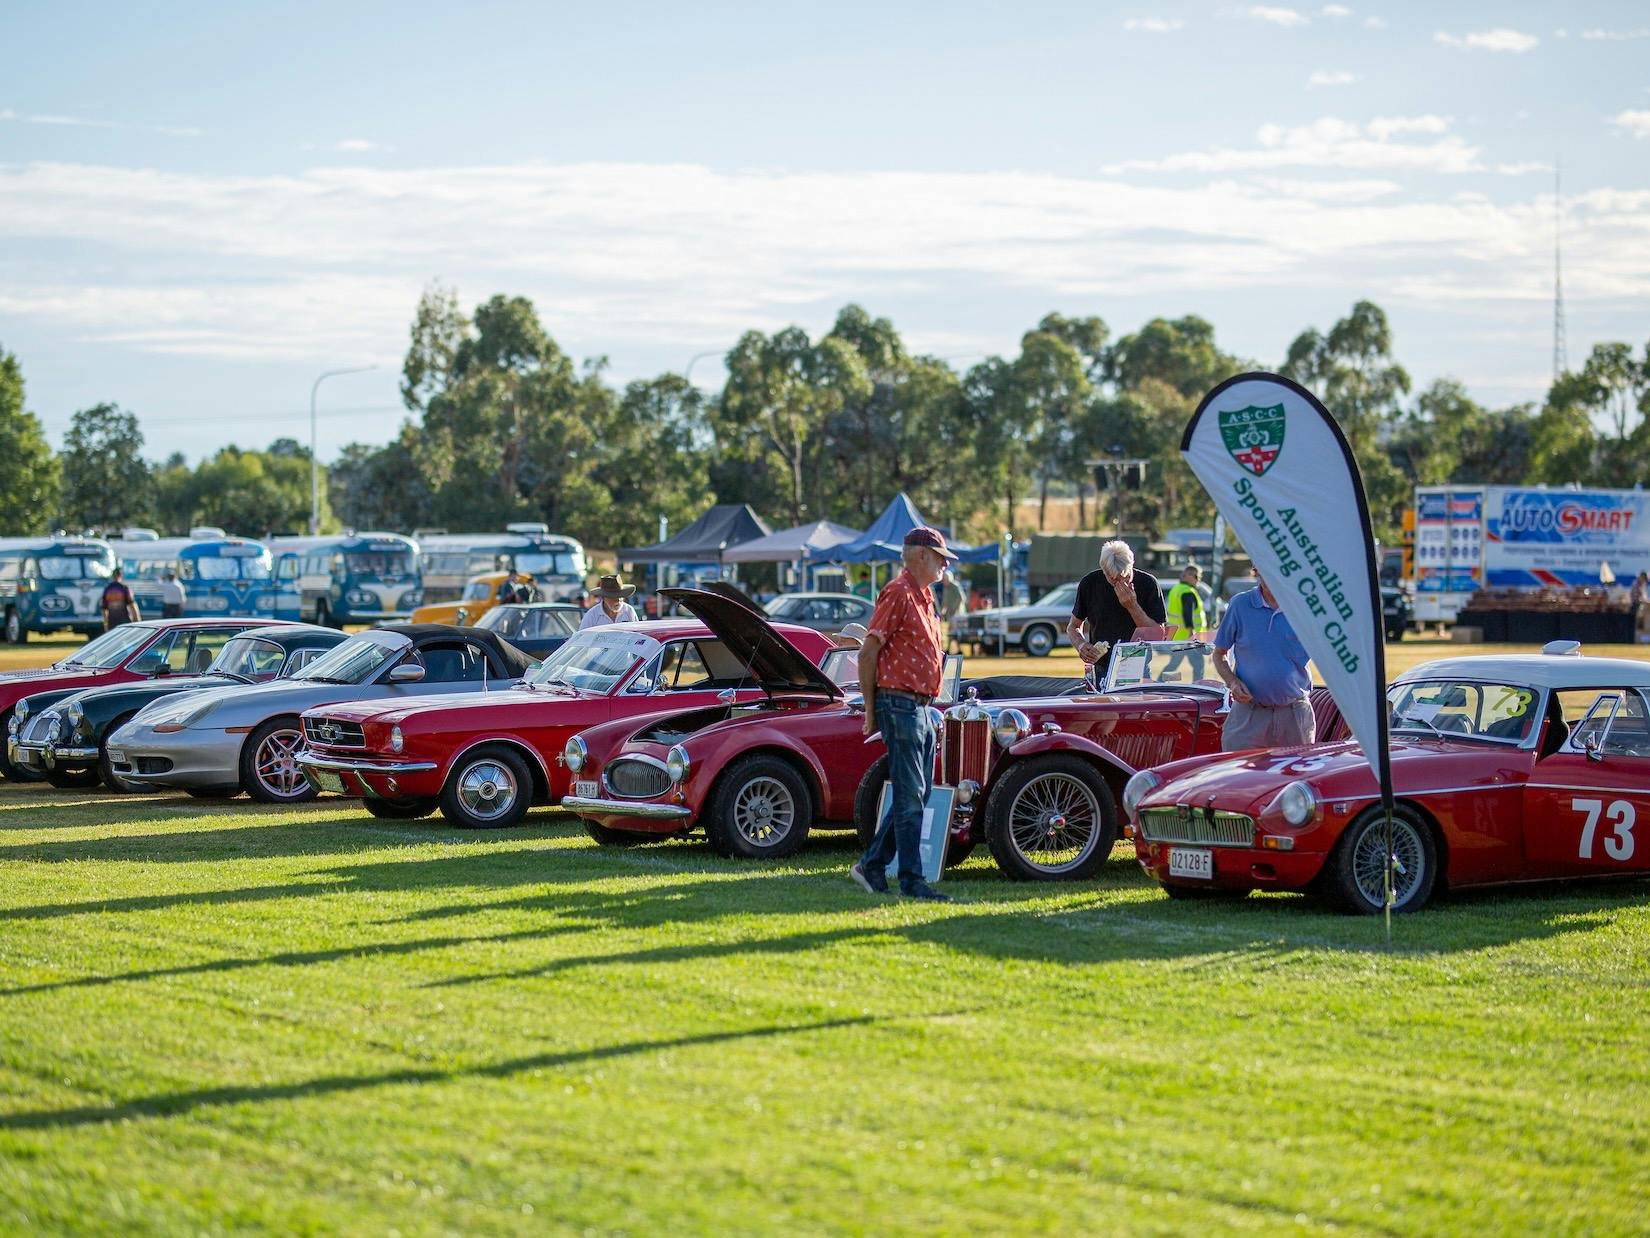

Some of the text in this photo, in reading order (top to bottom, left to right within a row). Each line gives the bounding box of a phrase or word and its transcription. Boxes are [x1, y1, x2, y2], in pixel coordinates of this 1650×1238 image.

[1233, 477, 1360, 674] Sporting Car Club
[1277, 507, 1354, 622] Australian
[1492, 687, 1533, 717] 73
[1265, 756, 1335, 774] 73
[1571, 798, 1636, 861] 73
